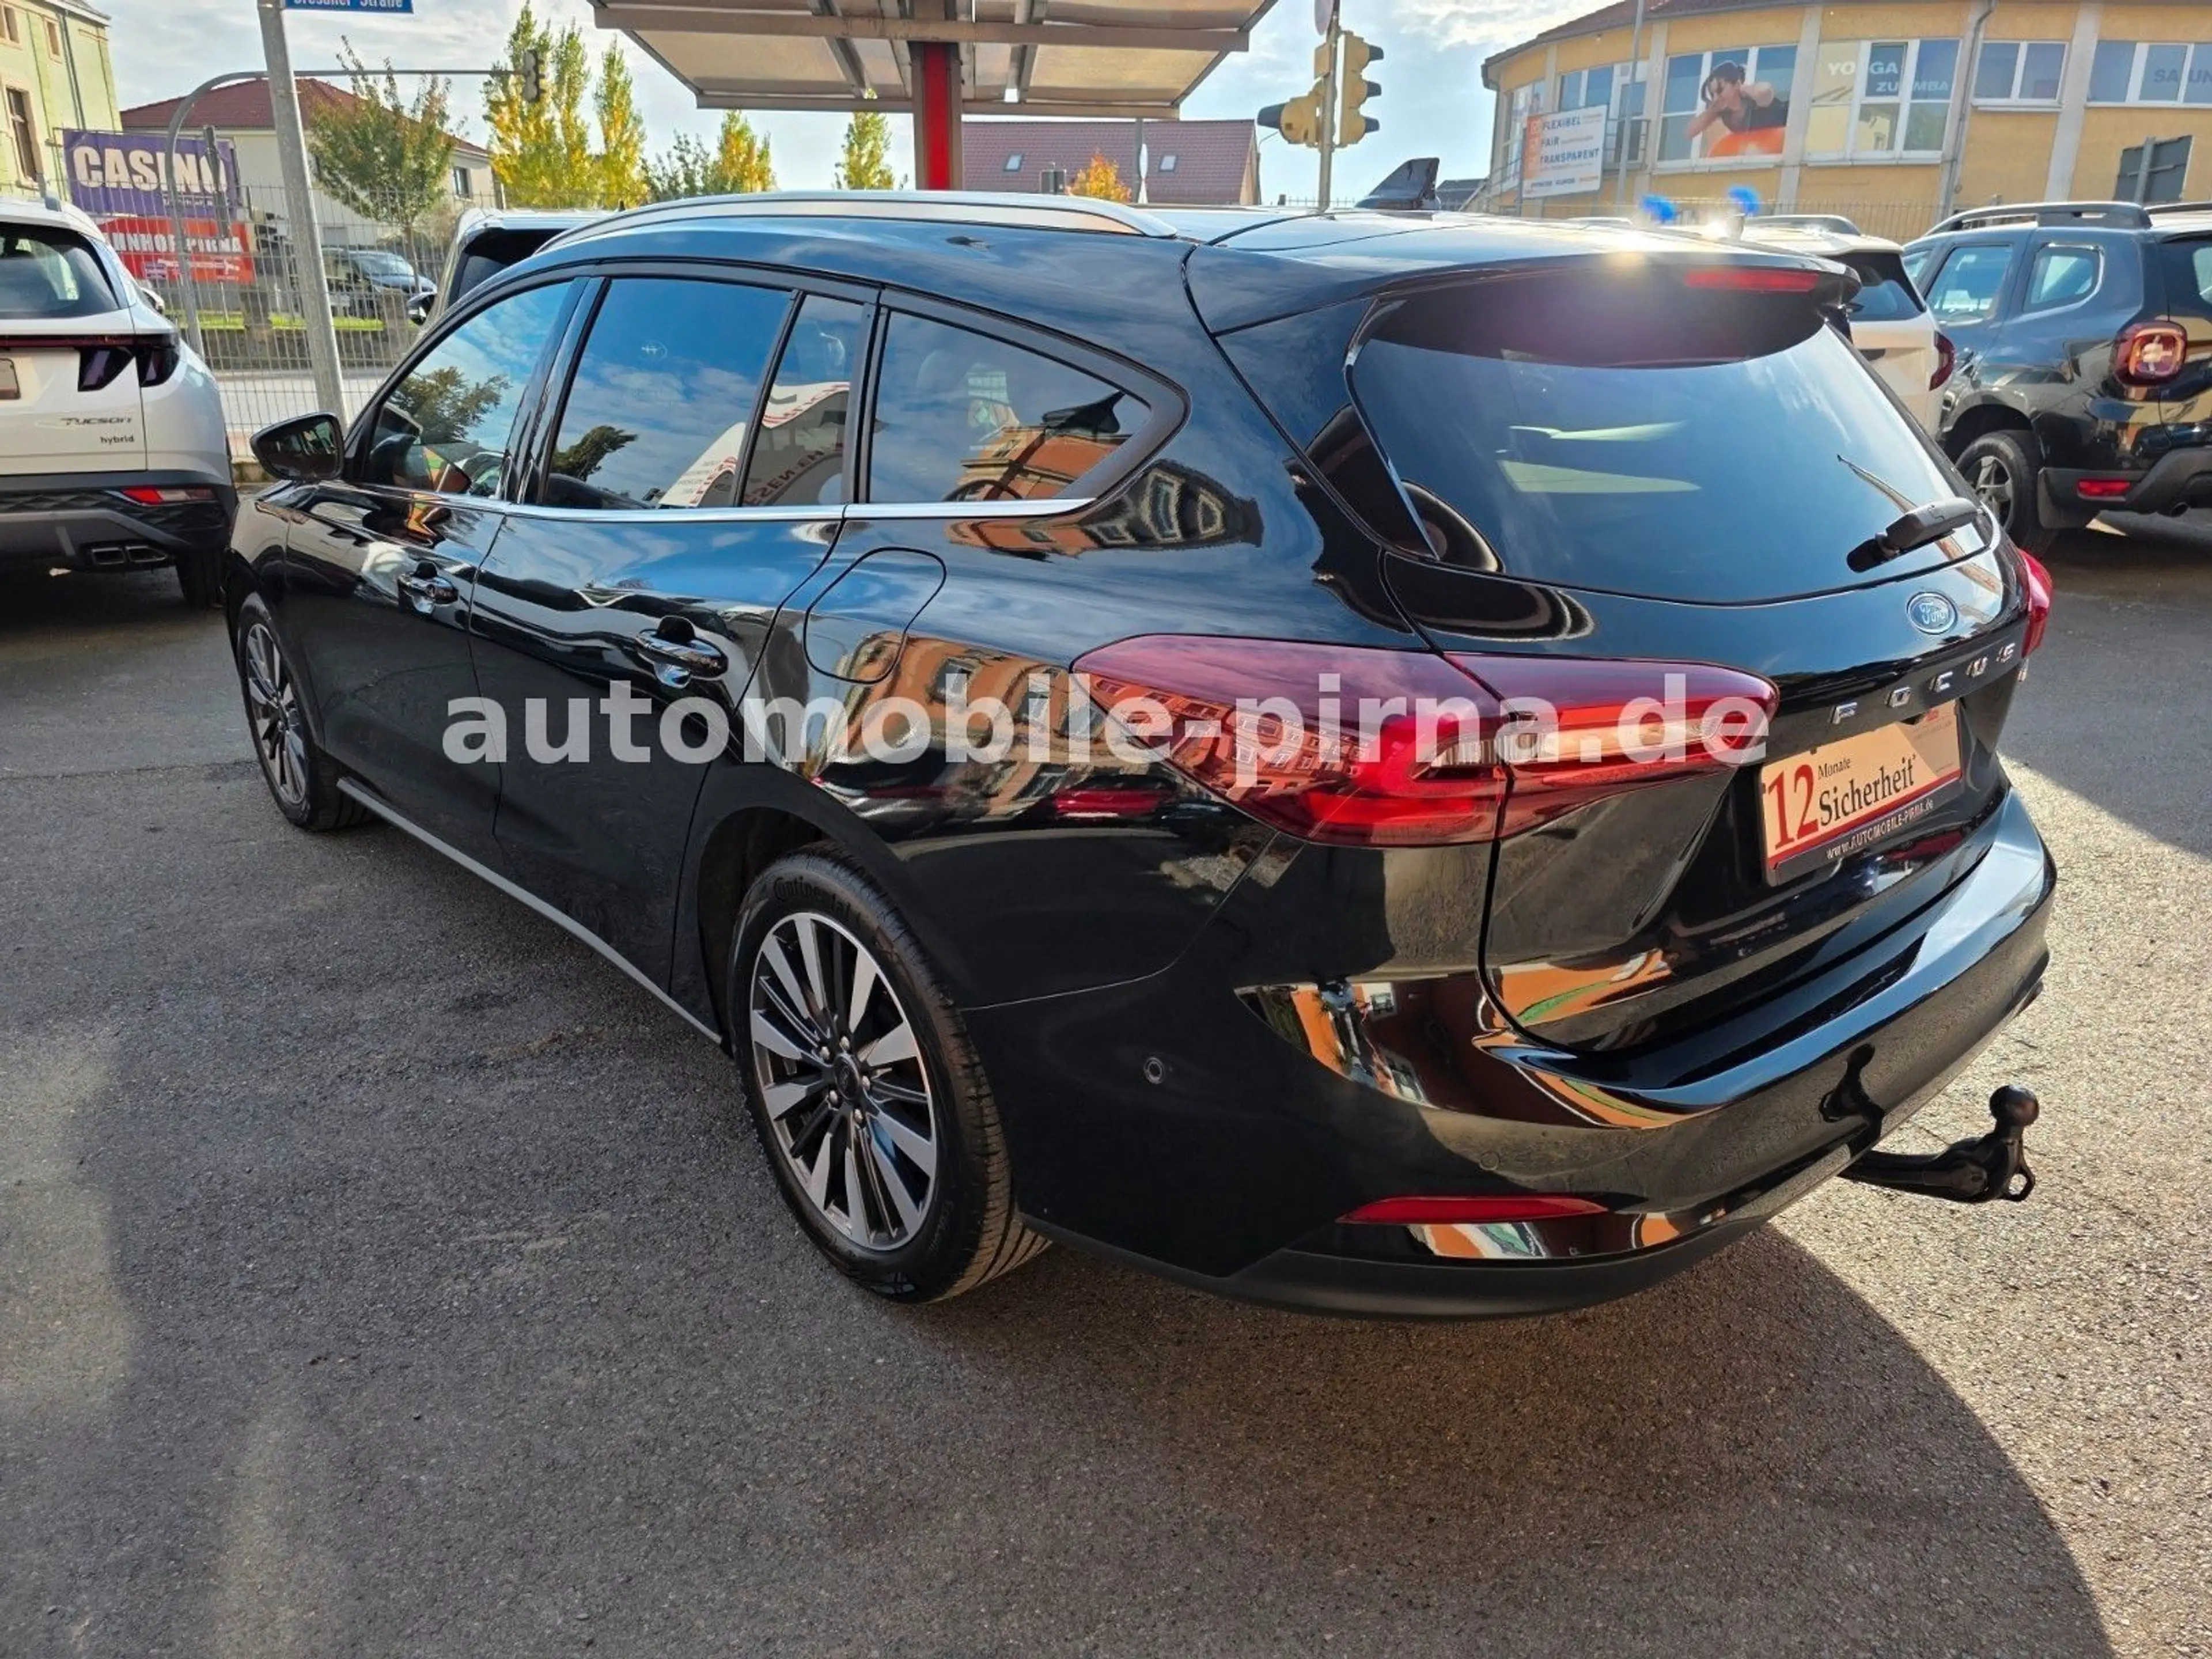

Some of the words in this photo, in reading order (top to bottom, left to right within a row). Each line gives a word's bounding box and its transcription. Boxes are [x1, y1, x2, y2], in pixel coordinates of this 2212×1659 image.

[73, 146, 228, 194] CASINO
[1540, 147, 1599, 164] TRANSPARENT
[100, 434, 135, 445] hybrid
[1830, 642, 2016, 724] FOCUS
[1768, 764, 1819, 850] 12
[1818, 757, 1851, 779] Monate
